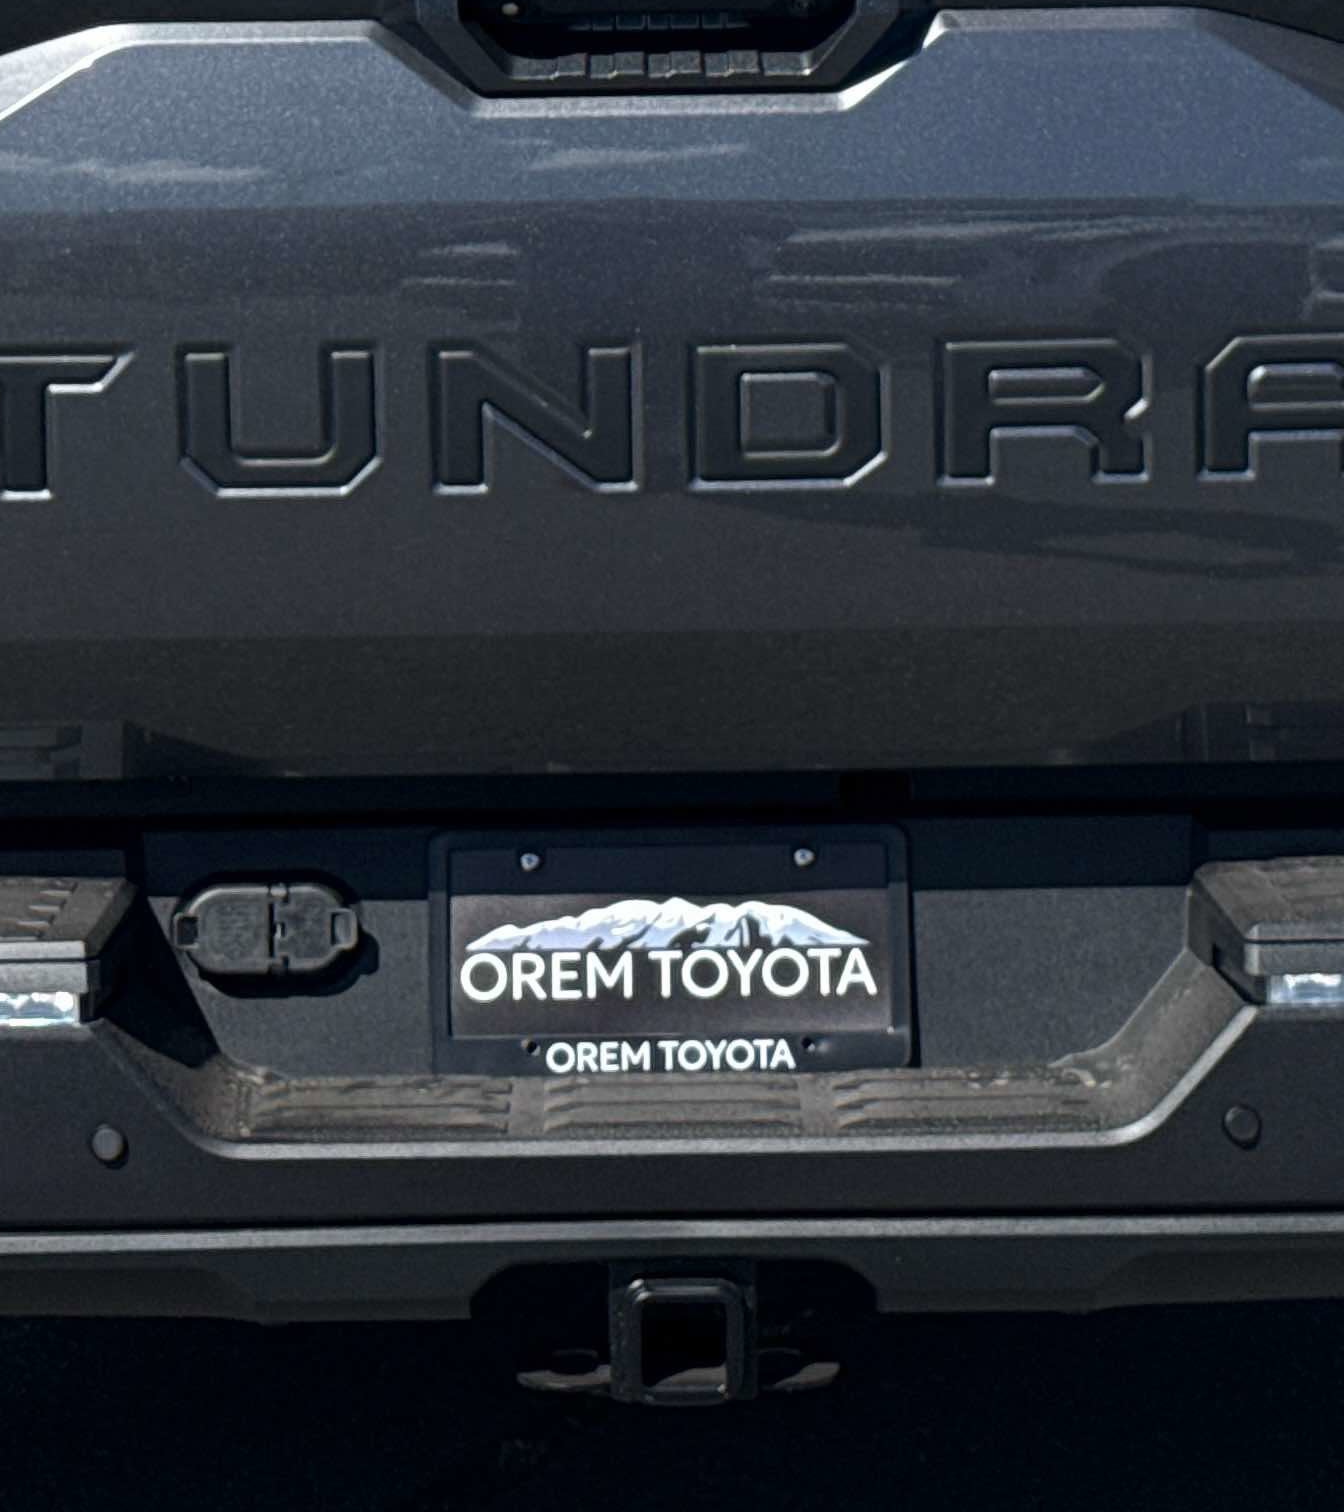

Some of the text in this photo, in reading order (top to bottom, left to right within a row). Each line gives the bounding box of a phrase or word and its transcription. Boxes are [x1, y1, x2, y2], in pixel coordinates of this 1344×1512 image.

[460, 947, 878, 1002] OREM TOYOTA
[545, 1038, 796, 1073] OREM TOYOTA
